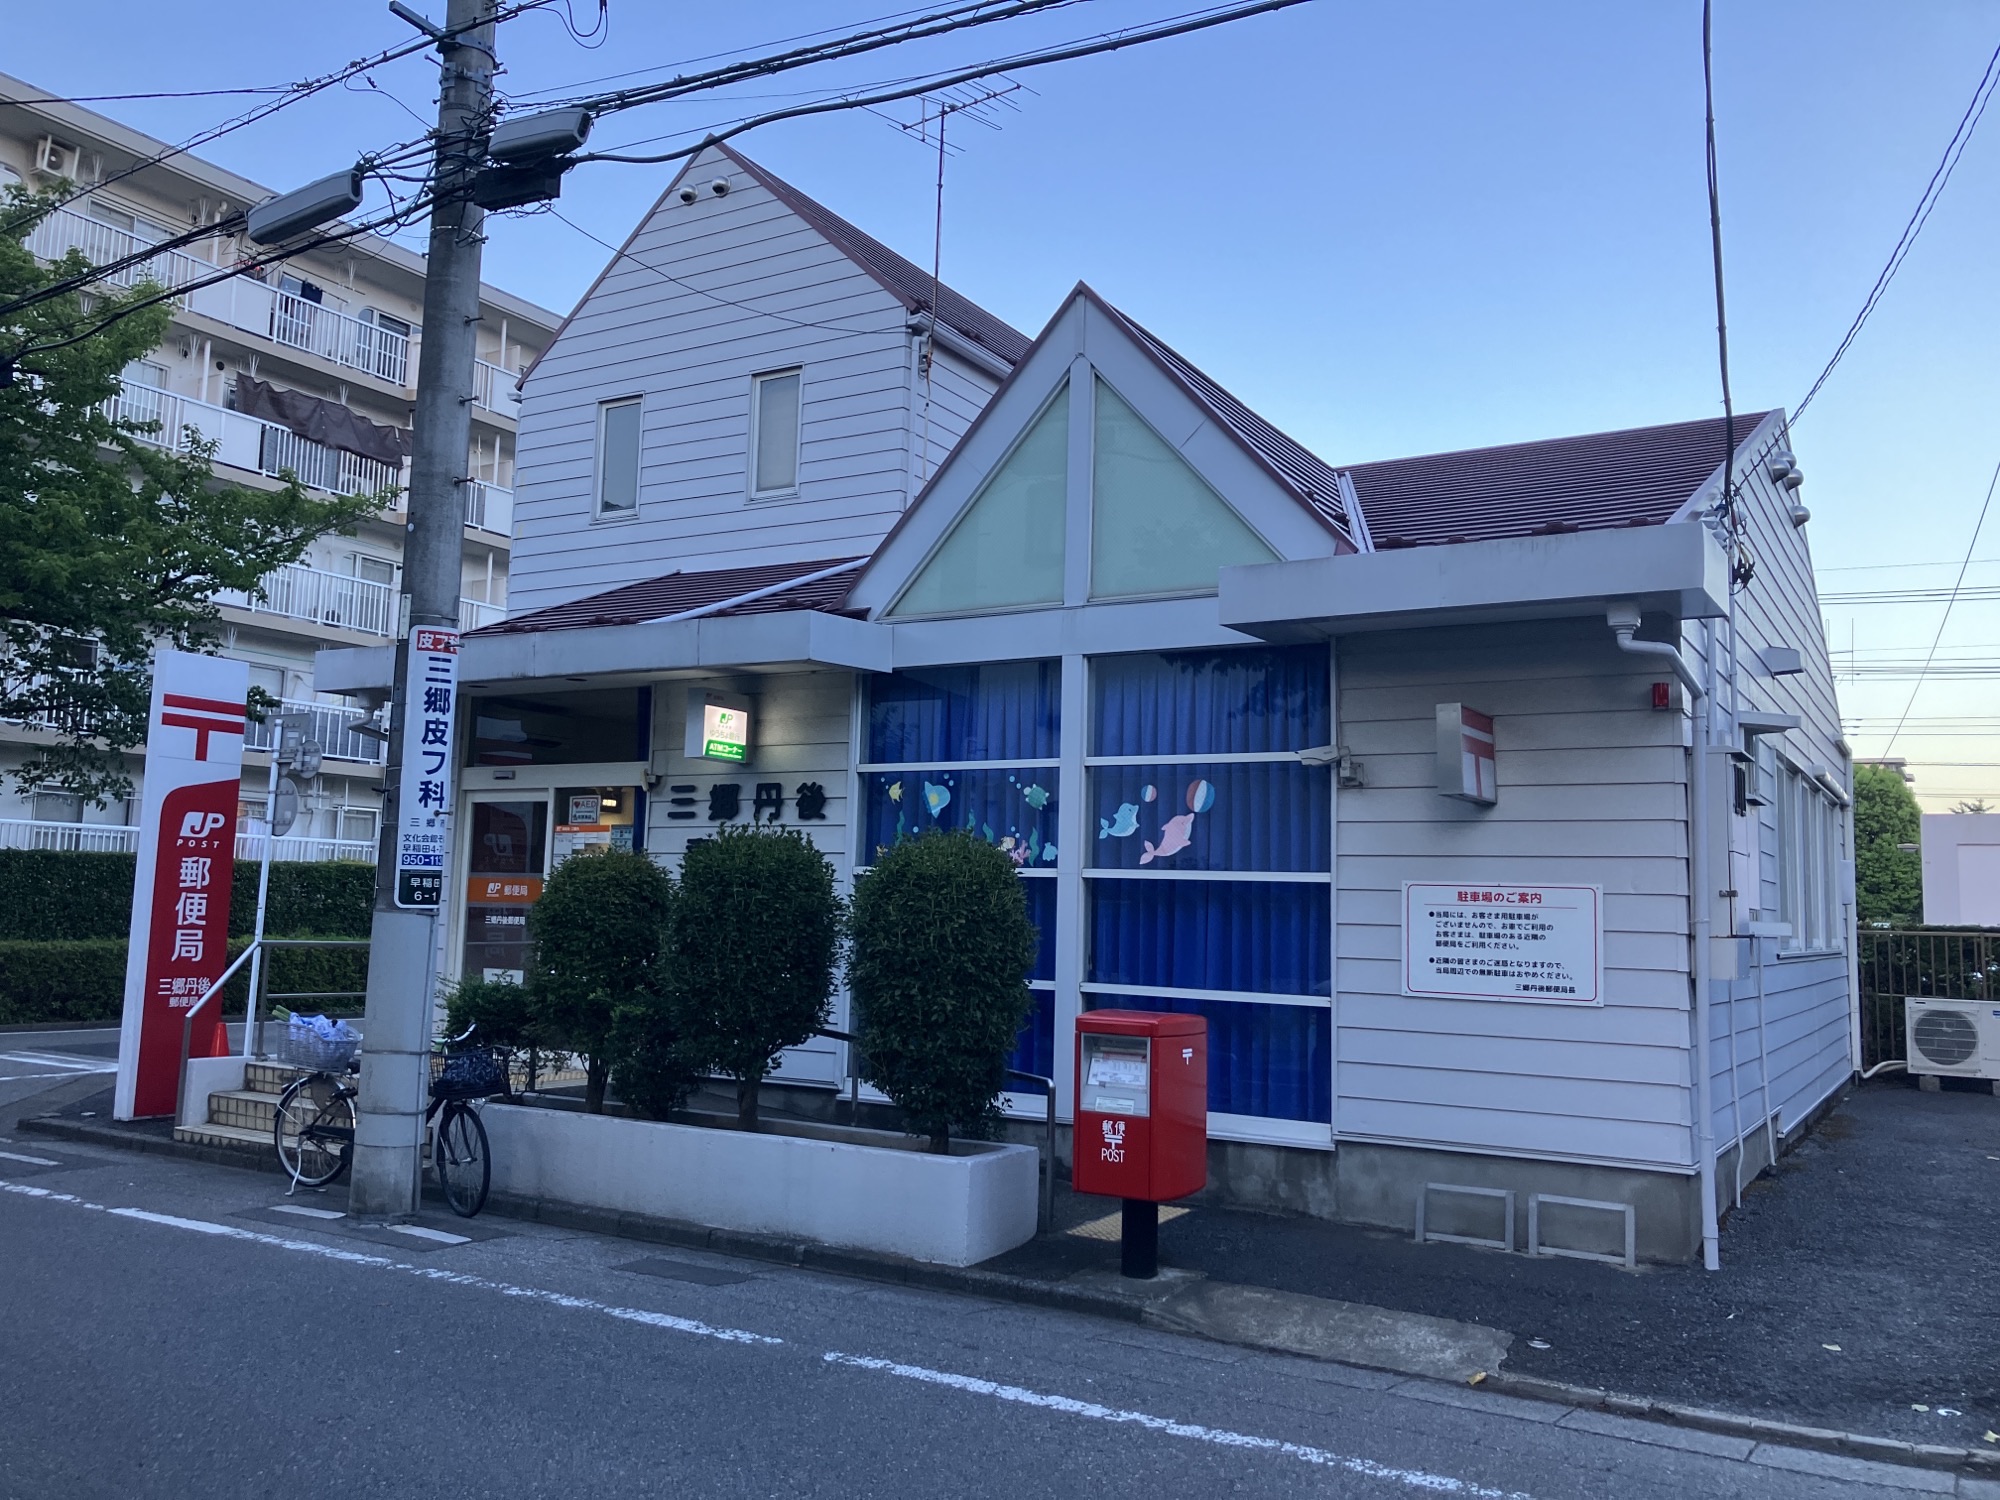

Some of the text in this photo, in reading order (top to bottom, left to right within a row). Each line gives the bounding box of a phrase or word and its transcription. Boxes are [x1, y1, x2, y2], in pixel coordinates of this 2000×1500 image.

[418, 656, 452, 809] 三郷皮フ科
[580, 800, 597, 808] AED
[667, 782, 826, 820] 三郷丹後
[179, 811, 225, 838] JP
[176, 839, 220, 849] POST
[503, 884, 528, 897] 郵便局
[1456, 890, 1542, 904] 駐車場のご案内
[171, 856, 211, 962] 郵便局
[484, 915, 526, 926] 三郷丹後郵便局
[158, 976, 212, 996] 三郷丹後
[1515, 983, 1576, 994] 三郷丹後郵便局長
[168, 996, 200, 1008] 郵便局
[1101, 1119, 1126, 1137] 郵便
[1101, 1148, 1125, 1163] POST
